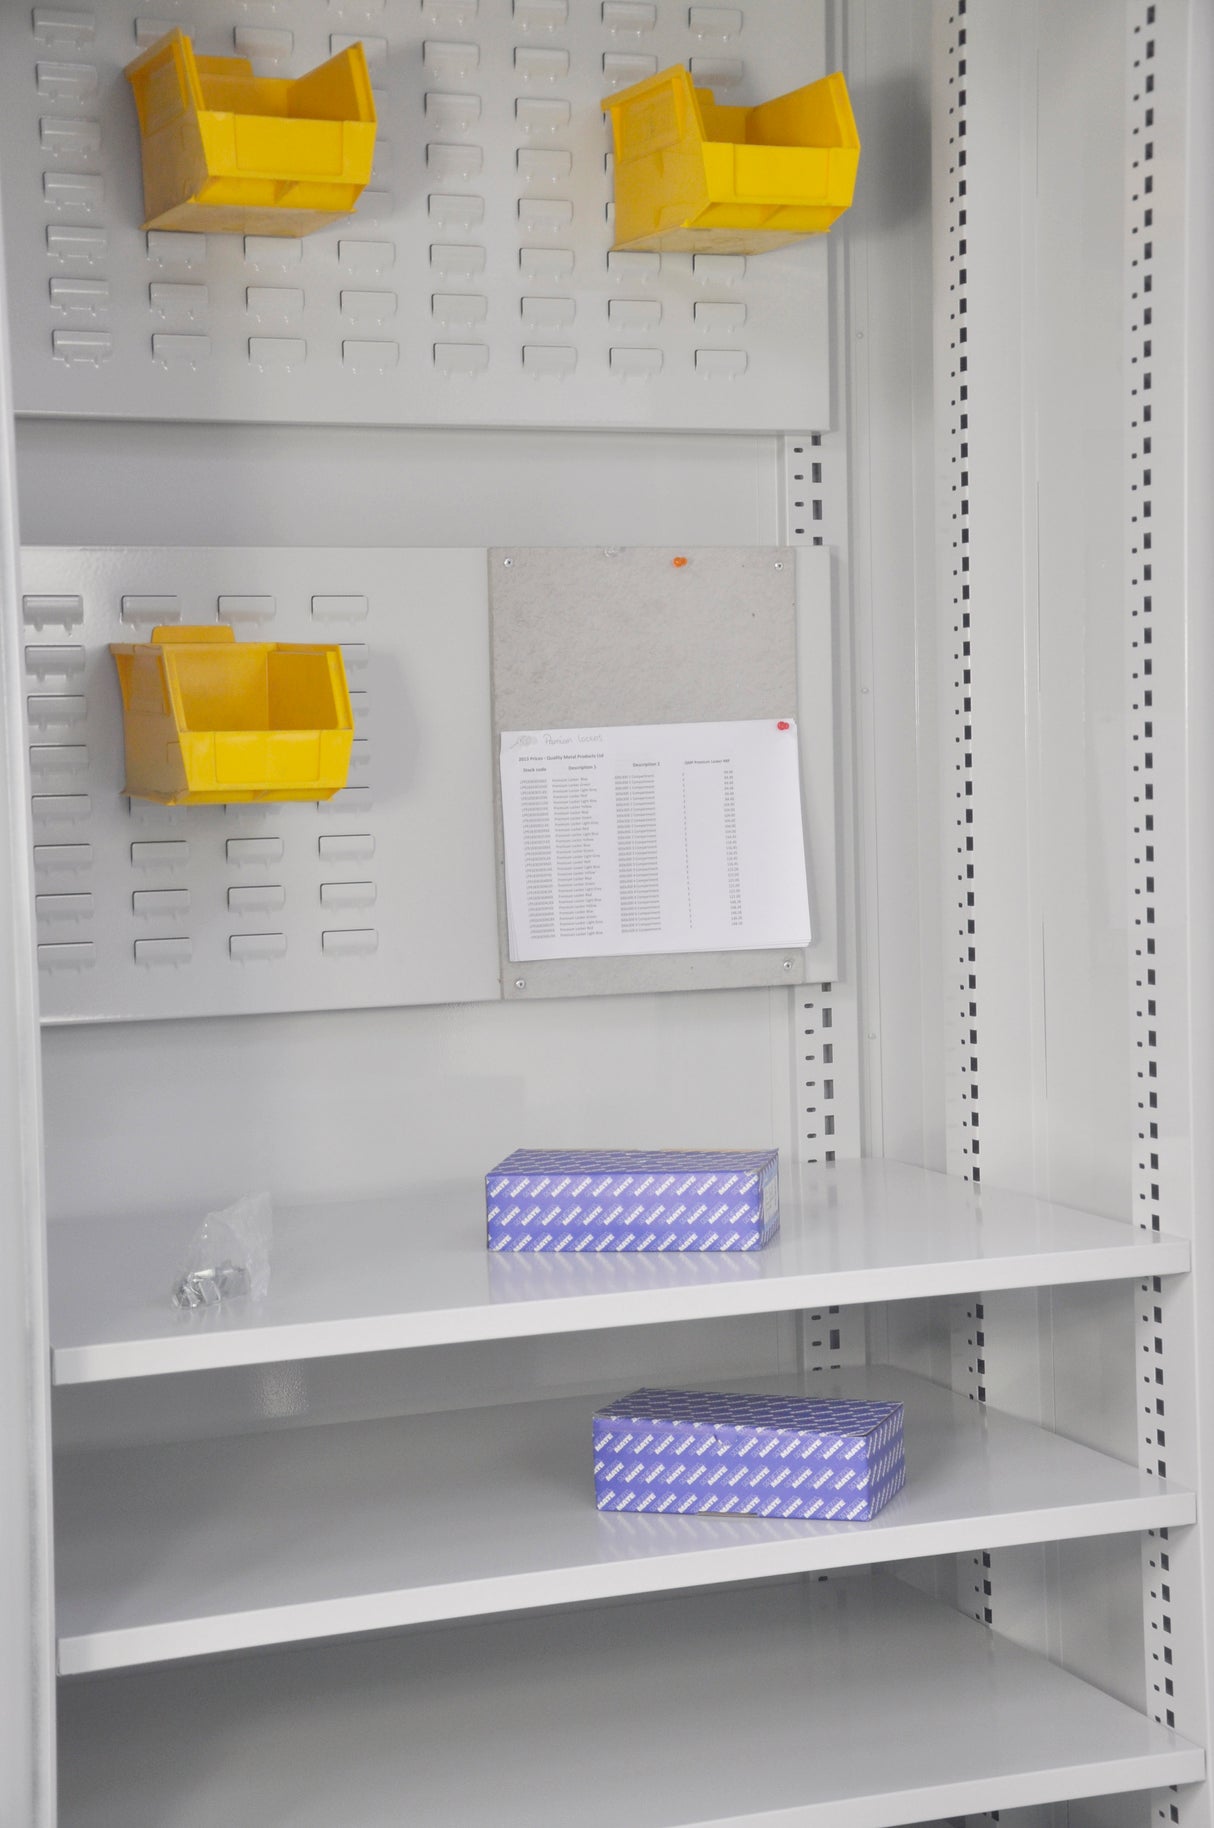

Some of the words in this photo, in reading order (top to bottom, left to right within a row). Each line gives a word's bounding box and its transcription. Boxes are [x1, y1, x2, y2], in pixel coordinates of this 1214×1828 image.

[491, 1179, 510, 1198] MATE
[511, 1178, 530, 1198] MATE
[531, 1178, 551, 1198] MATE
[551, 1178, 572, 1198] MATE
[572, 1177, 592, 1197] MATE
[593, 1177, 613, 1197] MATE
[613, 1177, 634, 1197] MATE
[635, 1177, 655, 1197] MATE
[655, 1176, 676, 1196] MATE
[677, 1176, 697, 1196] MATE
[697, 1176, 718, 1196] MATE
[719, 1175, 739, 1195] MATE
[501, 1207, 521, 1226] MATE
[521, 1207, 541, 1226] MATE
[542, 1207, 562, 1226] MATE
[562, 1207, 582, 1226] MATE
[583, 1206, 603, 1226] MATE
[604, 1206, 624, 1226] MATE
[625, 1206, 645, 1226] MATE
[645, 1205, 666, 1225] MATE
[666, 1205, 687, 1225] MATE
[687, 1205, 708, 1225] MATE
[708, 1205, 729, 1225] MATE
[730, 1204, 750, 1224] MATE
[535, 1235, 553, 1251] MATE
[555, 1234, 574, 1252] MATE
[575, 1234, 594, 1251] MATE
[596, 1234, 615, 1251] MATE
[617, 1234, 636, 1251] MATE
[638, 1234, 656, 1251] MATE
[658, 1234, 677, 1251] MATE
[679, 1233, 698, 1251] MATE
[700, 1233, 719, 1251] MATE
[721, 1233, 740, 1251] MATE
[595, 1433, 614, 1452] MATE
[614, 1434, 634, 1454] MATE
[634, 1435, 654, 1455] MATE
[655, 1435, 675, 1455] MATE
[675, 1436, 696, 1456] MATE
[696, 1436, 717, 1456] MATE
[738, 1438, 759, 1457] MATE
[759, 1438, 780, 1458] MATE
[780, 1439, 801, 1459] MATE
[802, 1439, 823, 1460] MATE
[823, 1440, 844, 1460] MATE
[845, 1439, 866, 1461] MATE
[605, 1463, 625, 1482] MATE
[625, 1464, 645, 1483] MATE
[645, 1464, 666, 1484] MATE
[666, 1465, 686, 1485] MATE
[687, 1465, 707, 1485] MATE
[708, 1466, 728, 1486] MATE
[729, 1467, 749, 1487] MATE
[750, 1467, 770, 1488] MATE
[771, 1468, 792, 1488] MATE
[792, 1469, 813, 1489] MATE
[813, 1470, 834, 1490] MATE
[835, 1470, 856, 1490] MATE
[598, 1491, 616, 1510] MATE
[617, 1492, 636, 1511] MATE
[637, 1493, 657, 1512] MATE
[658, 1494, 677, 1513] MATE
[678, 1495, 698, 1513] MATE
[762, 1498, 782, 1516] MATE
[783, 1498, 803, 1517] MATE
[805, 1499, 825, 1518] MATE
[826, 1500, 846, 1519] MATE
[847, 1500, 868, 1520] MATE
